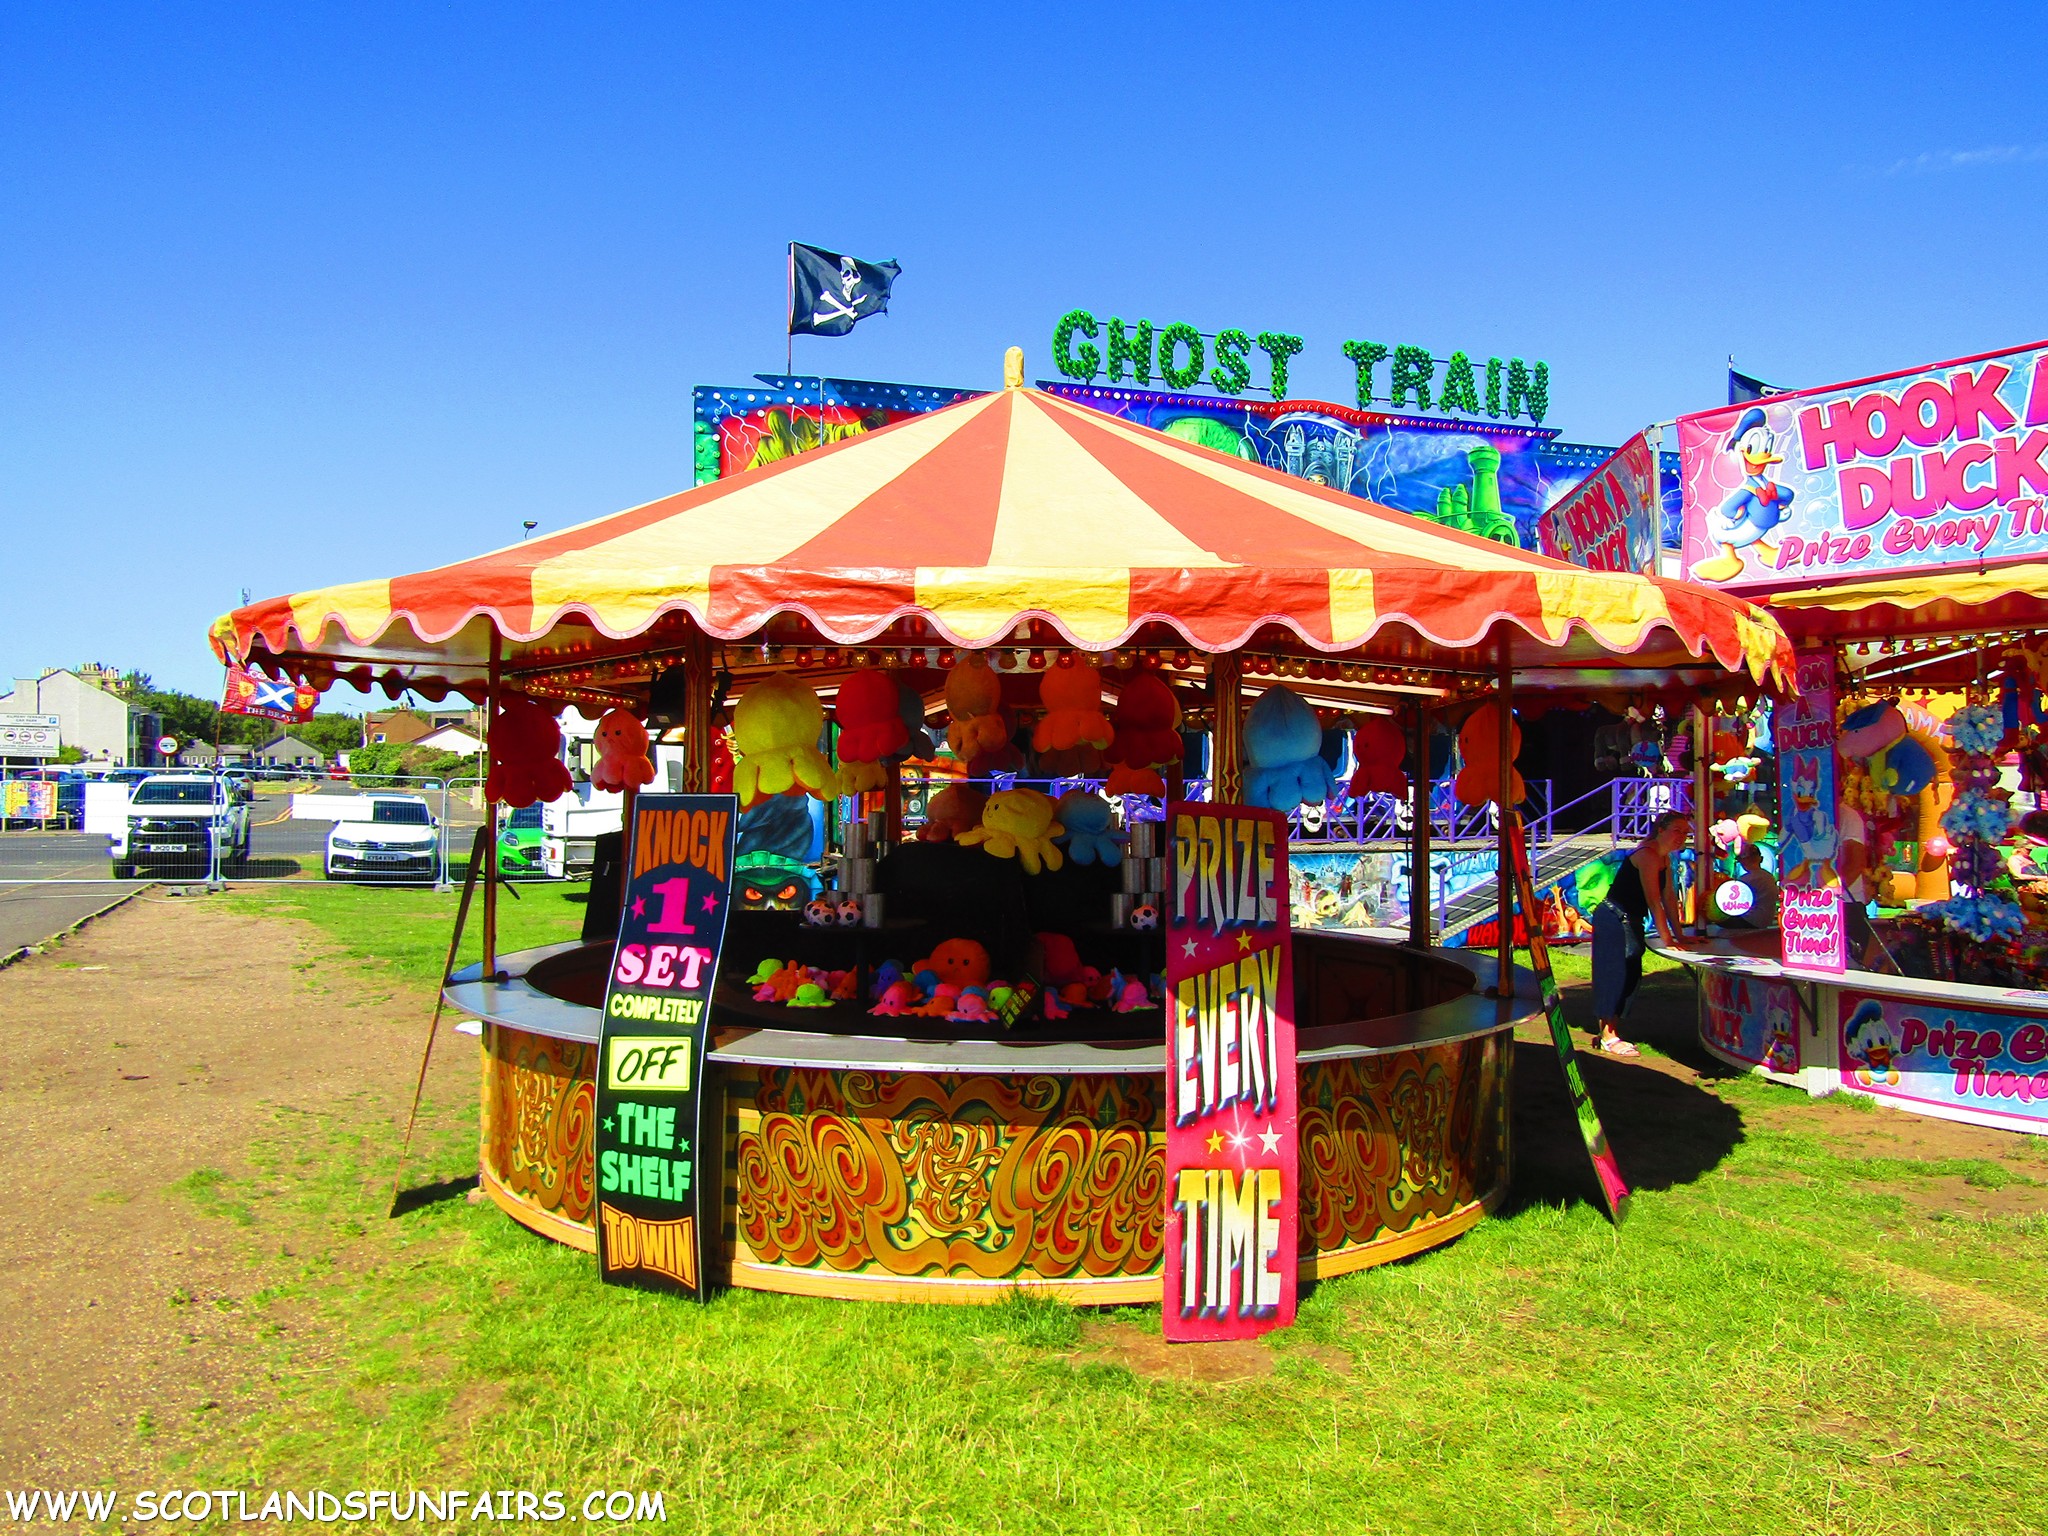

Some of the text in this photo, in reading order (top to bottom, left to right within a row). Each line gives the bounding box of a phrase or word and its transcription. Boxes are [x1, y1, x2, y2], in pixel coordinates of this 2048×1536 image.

[1052, 308, 1550, 423] GHOST TRAIN
[1799, 361, 2018, 470] HOOK
[1836, 428, 2048, 531] DUCK
[1564, 469, 1632, 555] HOOK A
[1776, 495, 2048, 570] Prize Every Ti
[1797, 661, 1830, 692] OK
[1794, 696, 1813, 722] A
[1778, 719, 1834, 753] DUCK
[634, 809, 729, 882] KNOCK
[1173, 814, 1278, 934] PRIZE
[1729, 885, 1740, 900] 3
[1783, 884, 1834, 908] Prize
[647, 877, 697, 934] 1
[1783, 909, 1838, 935] Every
[1785, 931, 1838, 955] Time!
[616, 944, 711, 988] SET
[610, 994, 704, 1024] COMPLETELY
[1736, 978, 1752, 1014] A
[1175, 945, 1282, 1124] EVERY
[1900, 1017, 2003, 1059] Prize
[617, 1045, 684, 1083] OFF
[617, 1103, 676, 1150] THE
[601, 1151, 692, 1202] SHELF
[1176, 1168, 1283, 1312] TIME
